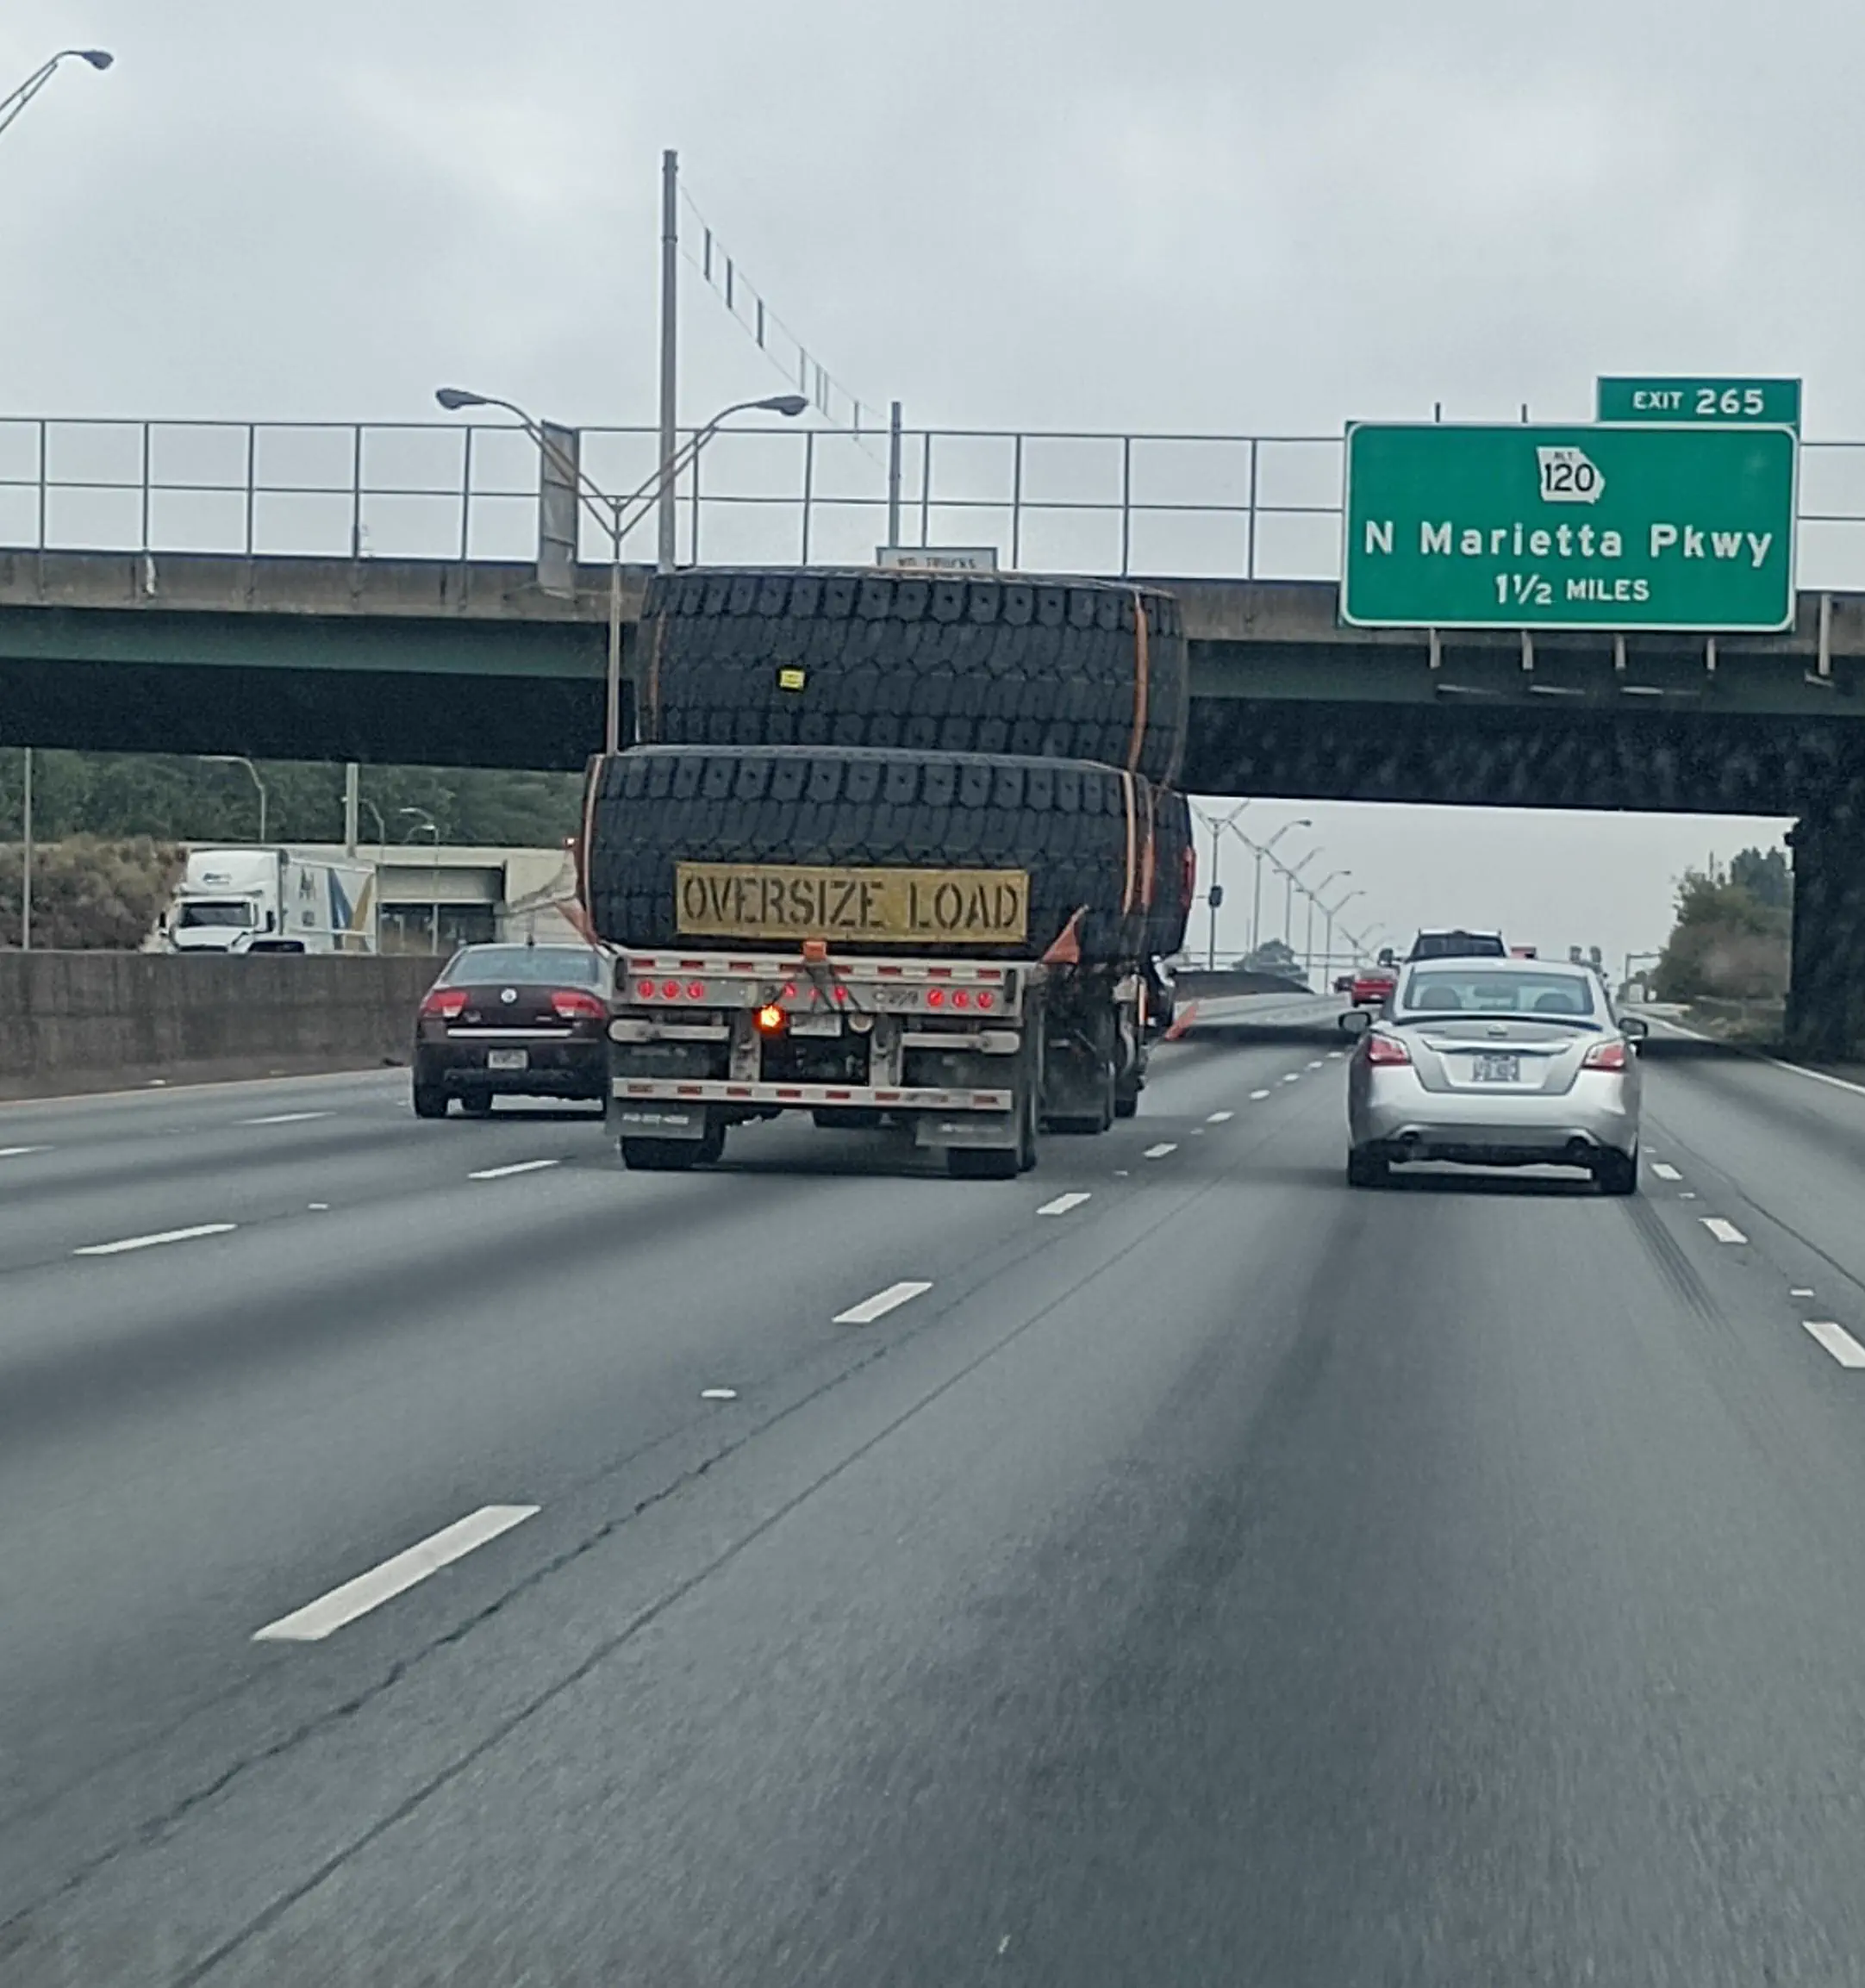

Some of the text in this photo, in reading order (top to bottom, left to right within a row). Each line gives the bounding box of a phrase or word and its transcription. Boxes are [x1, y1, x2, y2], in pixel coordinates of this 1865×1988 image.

[1633, 388, 1764, 415] EXIT 265
[1545, 463, 1594, 491] 120
[1365, 521, 1773, 568] N Marietta Pkwy
[1566, 578, 1650, 601] MILES
[683, 876, 1019, 931] OVERSIZE LOAD
